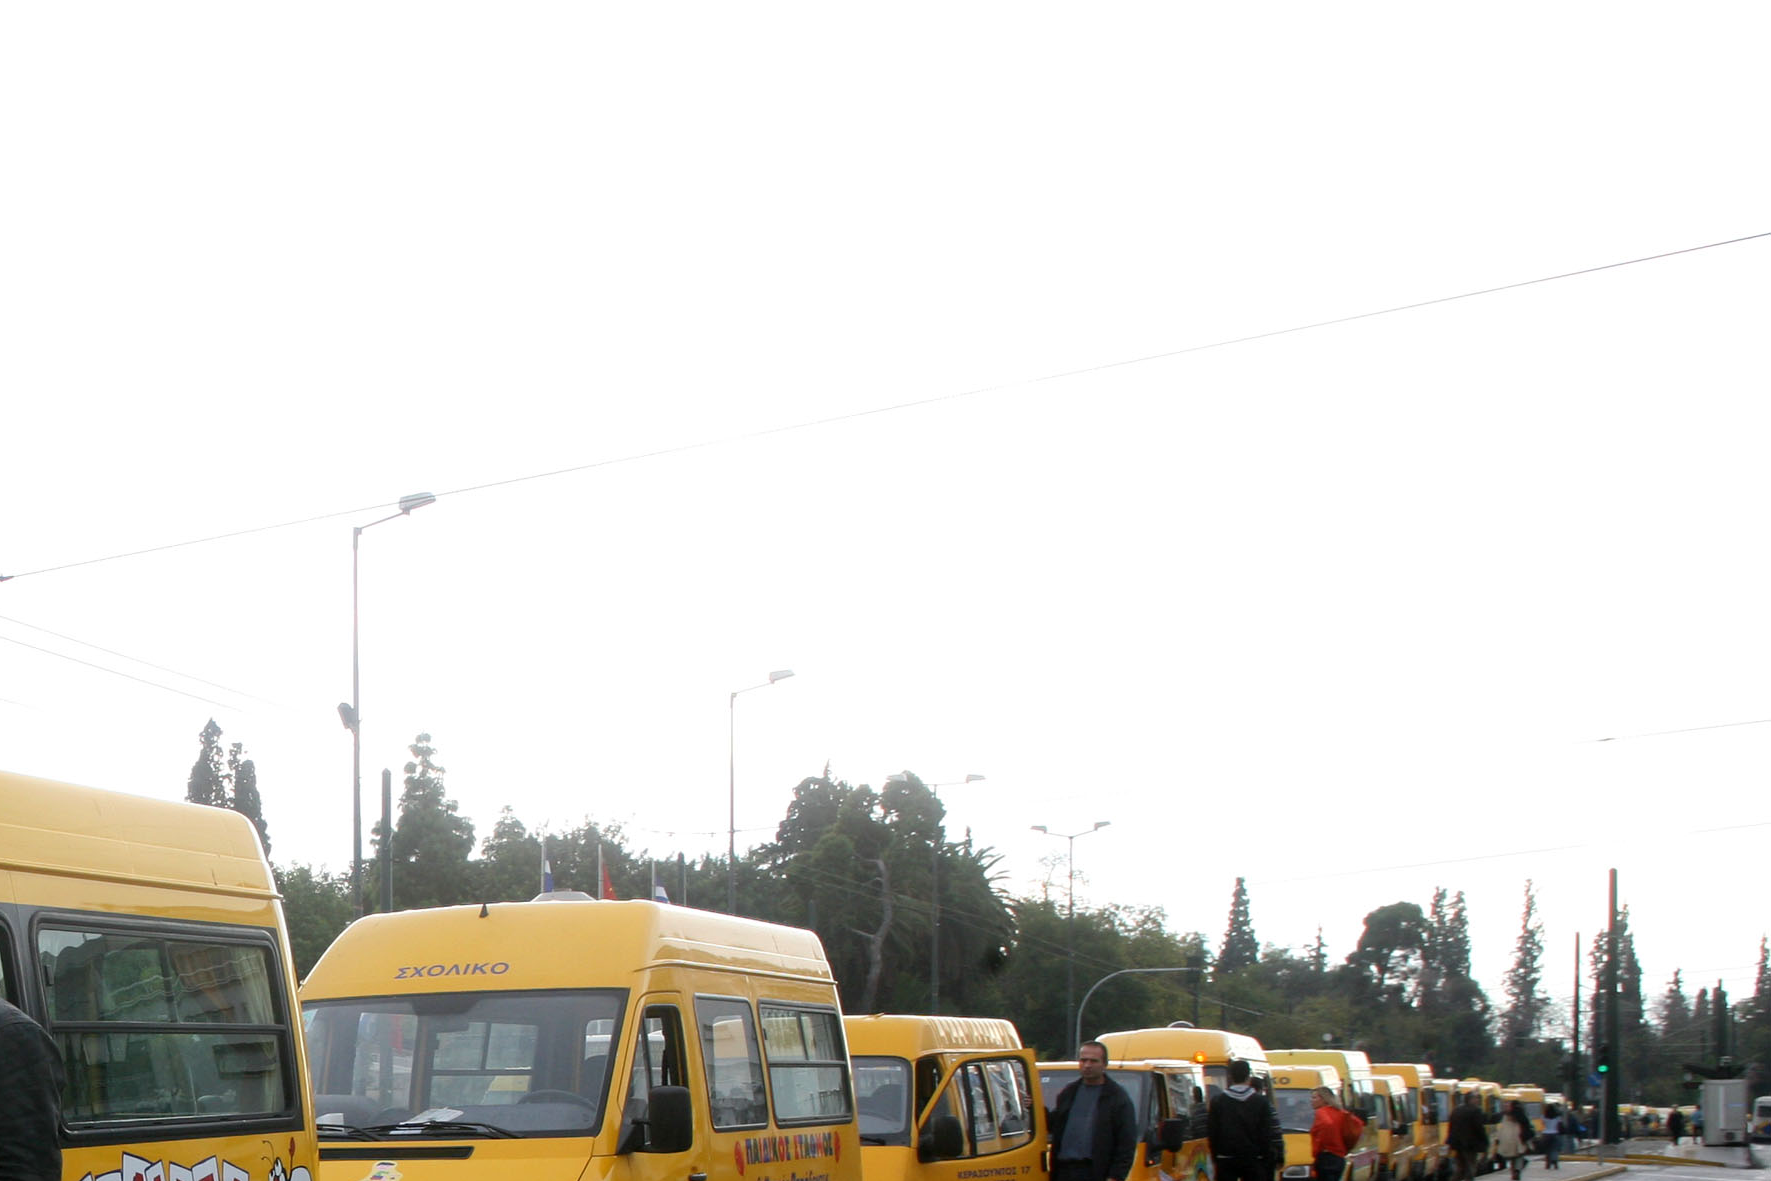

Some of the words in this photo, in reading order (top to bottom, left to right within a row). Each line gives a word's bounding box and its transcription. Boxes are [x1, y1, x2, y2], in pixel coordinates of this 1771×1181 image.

[393, 961, 511, 980] ΣΧΟΛΙΚΟ
[745, 1135, 791, 1165] ΠΑΙΔΙΚΟΣ
[793, 1132, 834, 1160] ΣΤΑΘΜΟΣ
[1021, 1165, 1031, 1175] 17
